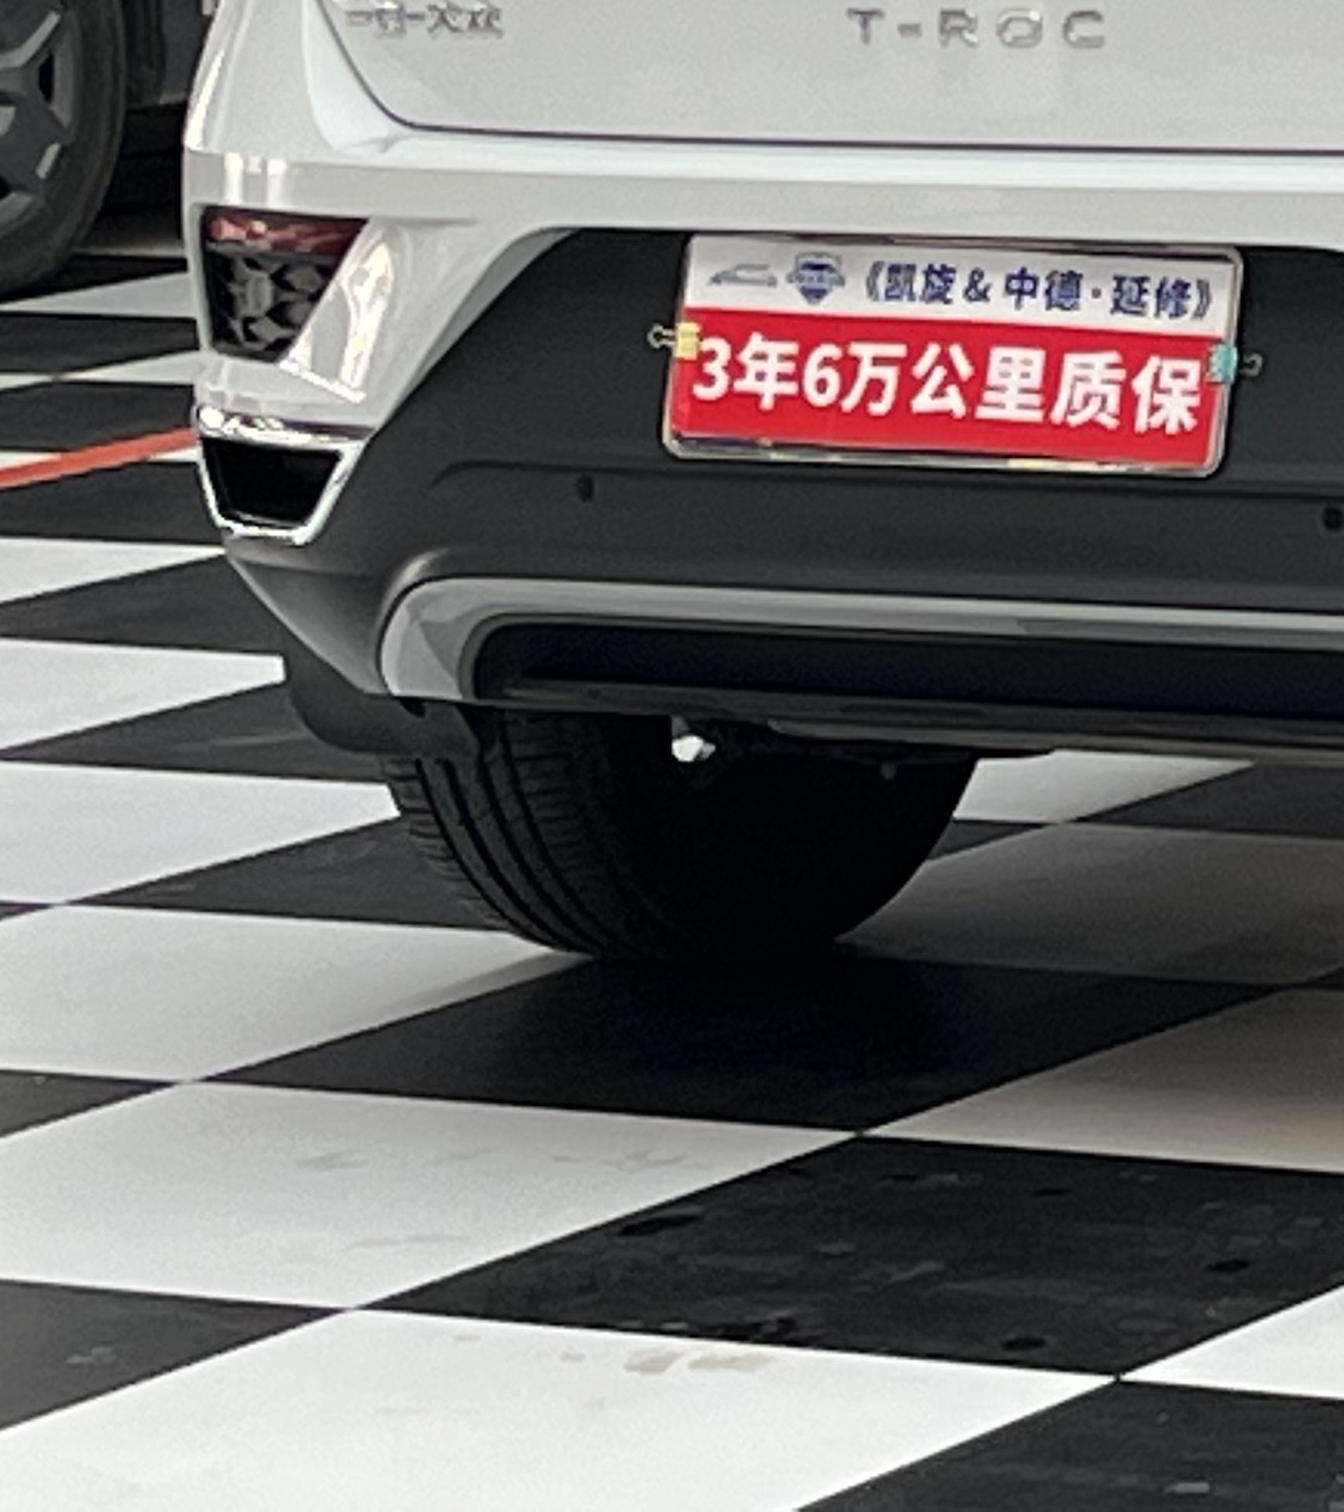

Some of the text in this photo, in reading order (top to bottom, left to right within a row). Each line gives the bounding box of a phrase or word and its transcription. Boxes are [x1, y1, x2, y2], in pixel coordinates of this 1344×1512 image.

[846, 7, 1105, 49] T-ROC
[692, 332, 1201, 435] 3年6万公里质保
